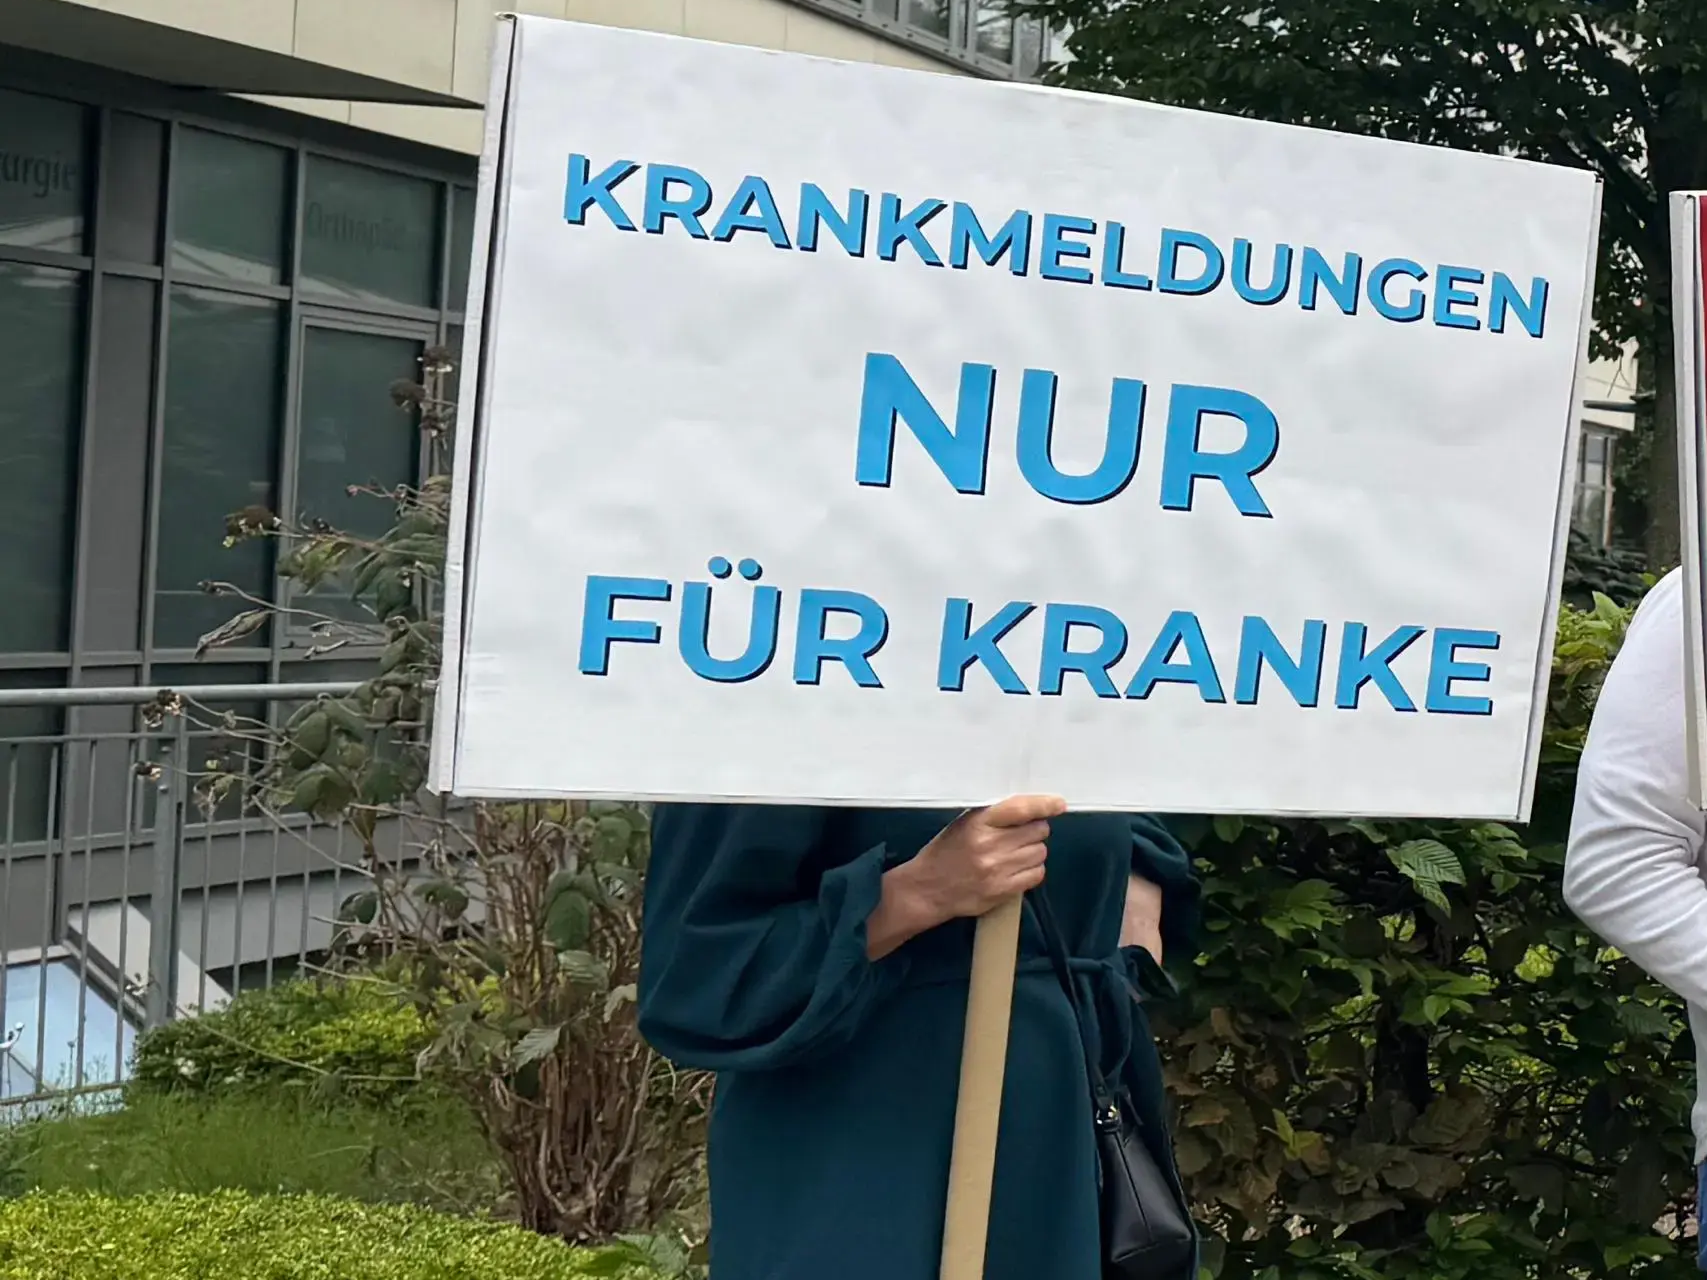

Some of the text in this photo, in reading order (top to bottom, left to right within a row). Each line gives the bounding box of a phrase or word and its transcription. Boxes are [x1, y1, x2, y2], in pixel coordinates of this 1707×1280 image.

[562, 153, 1549, 338] KRANKMELDUNGEN
[855, 352, 1280, 518] NUR
[577, 556, 1501, 716] FÜR KRANKE
